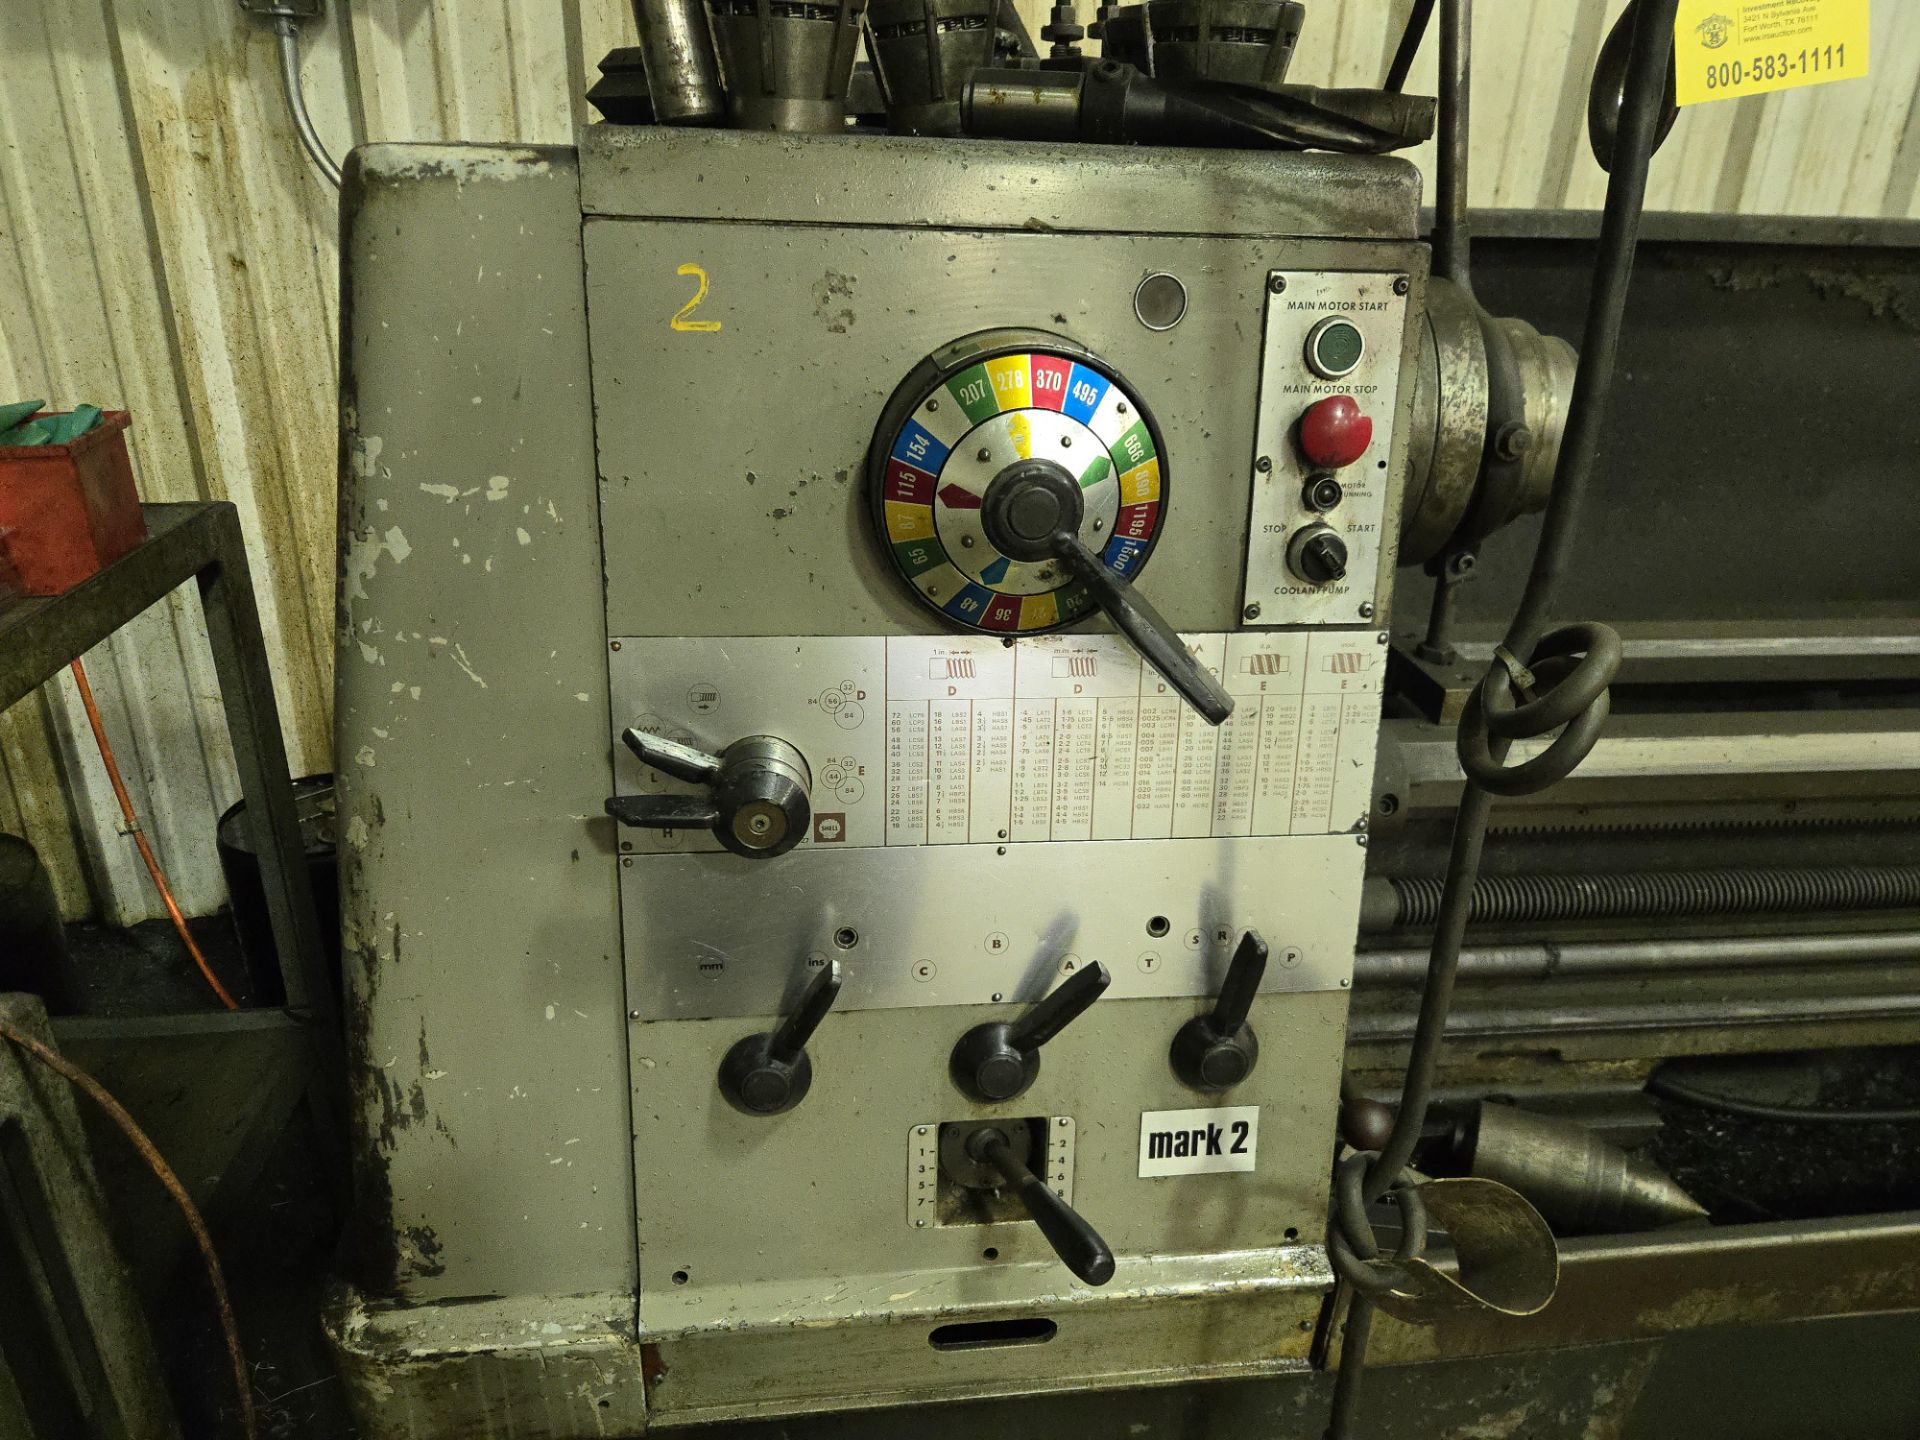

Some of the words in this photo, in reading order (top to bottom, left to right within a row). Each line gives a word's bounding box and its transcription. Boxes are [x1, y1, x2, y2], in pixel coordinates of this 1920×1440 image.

[1744, 14, 1760, 22] 3421
[1797, 14, 1818, 23] 76111
[1707, 42, 1844, 89] 800-583-1111
[670, 263, 722, 332] 2
[1287, 301, 1315, 310] MAIN
[1318, 301, 1356, 311] MOTOR
[1359, 302, 1388, 311] START
[996, 370, 1024, 391] 278
[1036, 369, 1062, 391] 370
[959, 379, 987, 406] 207
[1072, 380, 1098, 406] 495
[1283, 385, 1311, 393] MAIN
[1313, 385, 1351, 393] MOTOR
[1354, 385, 1378, 393] STOP
[906, 433, 931, 462] 154
[1124, 433, 1145, 463] 666
[897, 471, 917, 497] 115
[1129, 504, 1148, 536] 1195
[1263, 524, 1287, 533] STOP
[1347, 524, 1375, 532] START
[908, 547, 929, 566] 65
[1114, 540, 1137, 570] 1600
[1274, 587, 1319, 595] COOLANT
[1320, 587, 1350, 595] PUMP
[960, 597, 978, 611] 48
[995, 608, 1012, 621] 36
[1074, 684, 1083, 694] D
[1157, 683, 1166, 693] D
[1260, 682, 1267, 690] E
[1341, 680, 1347, 689] E
[856, 690, 866, 701] D
[948, 686, 957, 696] D
[858, 766, 865, 776] E
[650, 773, 658, 782] L
[663, 828, 673, 838] H
[1192, 935, 1199, 944] S
[1217, 931, 1227, 940] R
[992, 939, 1002, 949] B
[808, 957, 825, 967] ins
[1144, 958, 1154, 967] T
[1287, 953, 1296, 962] P
[1064, 961, 1075, 970] A
[919, 966, 928, 976] C
[1148, 1123, 1223, 1159] mark
[1230, 1120, 1249, 1154] 2
[920, 1148, 924, 1156] 1
[918, 1165, 925, 1173] 3
[918, 1182, 925, 1190] 5
[918, 1198, 925, 1207] 7
